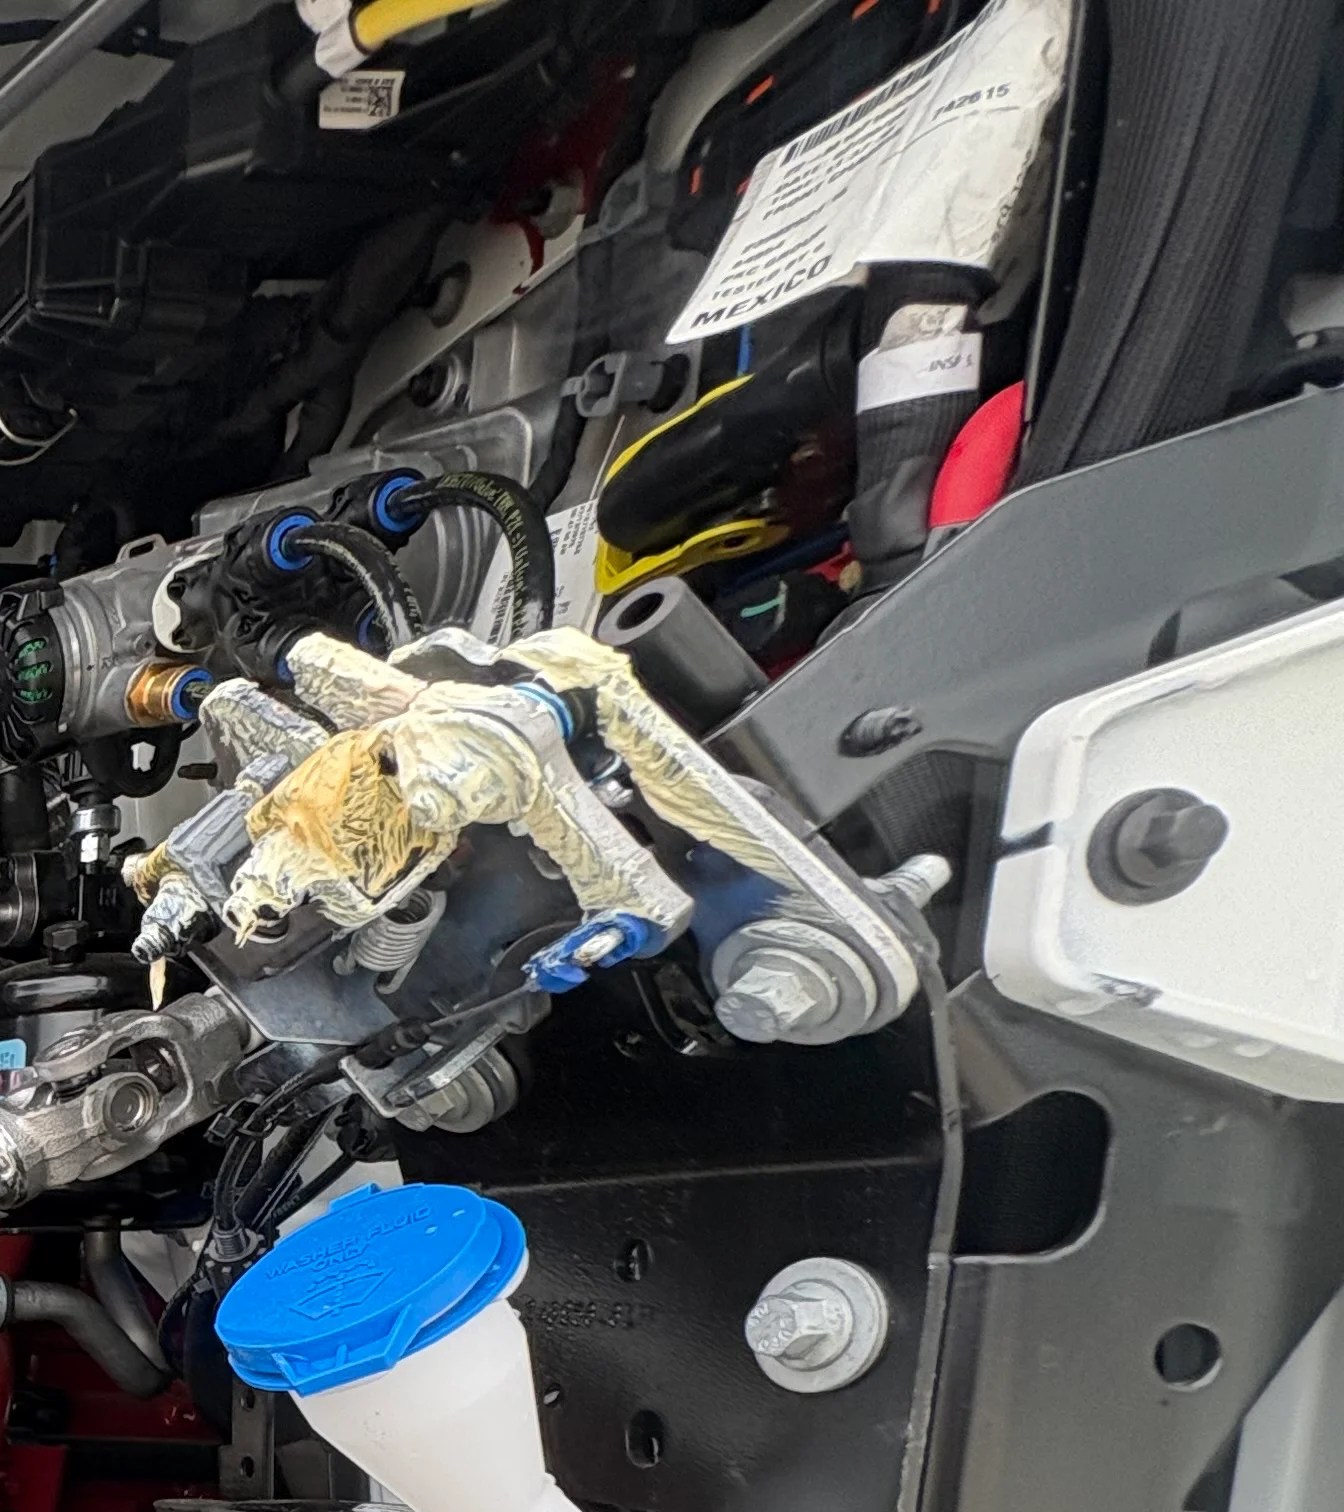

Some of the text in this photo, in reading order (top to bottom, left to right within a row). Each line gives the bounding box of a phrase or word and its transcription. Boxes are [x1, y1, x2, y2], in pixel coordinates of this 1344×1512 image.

[691, 255, 832, 329] MEXICO
[265, 1204, 432, 1280] WASHER FLUID
[310, 1243, 371, 1271] ONLY
